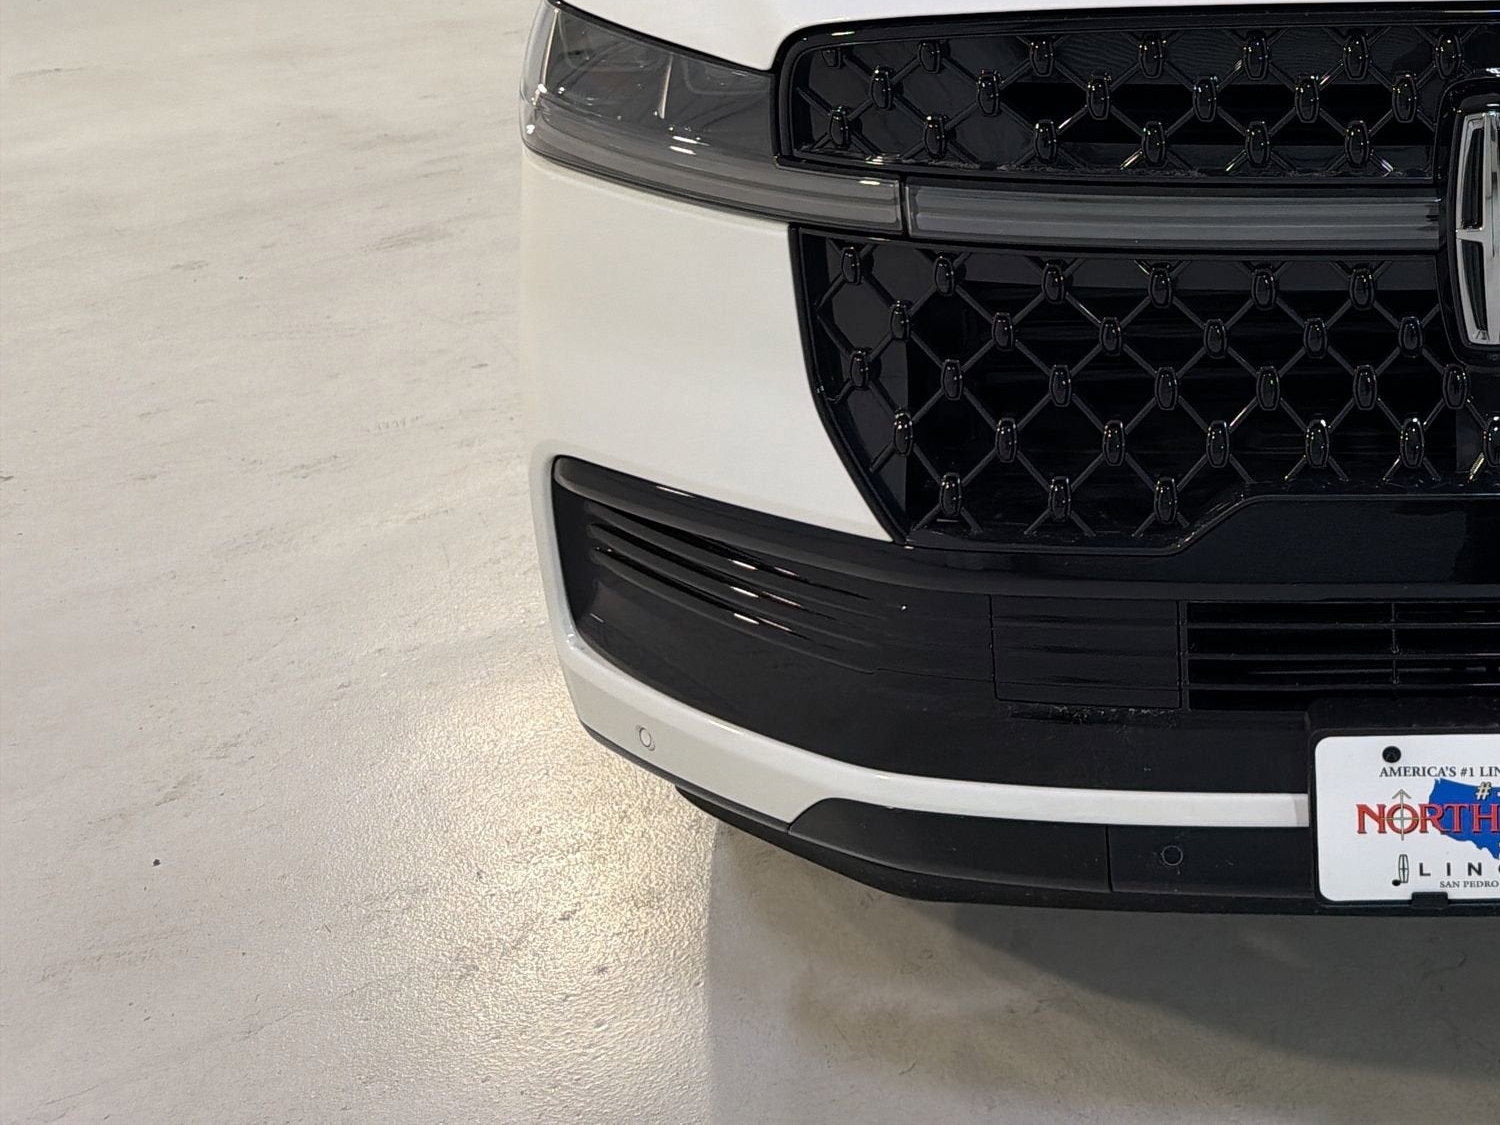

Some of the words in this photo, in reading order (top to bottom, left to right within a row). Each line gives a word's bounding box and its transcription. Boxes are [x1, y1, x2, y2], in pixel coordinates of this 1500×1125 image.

[1379, 765, 1457, 778] AMERICA'S
[1460, 766, 1475, 777] #1
[1356, 802, 1500, 835] NORTH
[1439, 880, 1460, 889] SAN
[1463, 880, 1500, 888] PEDRO
